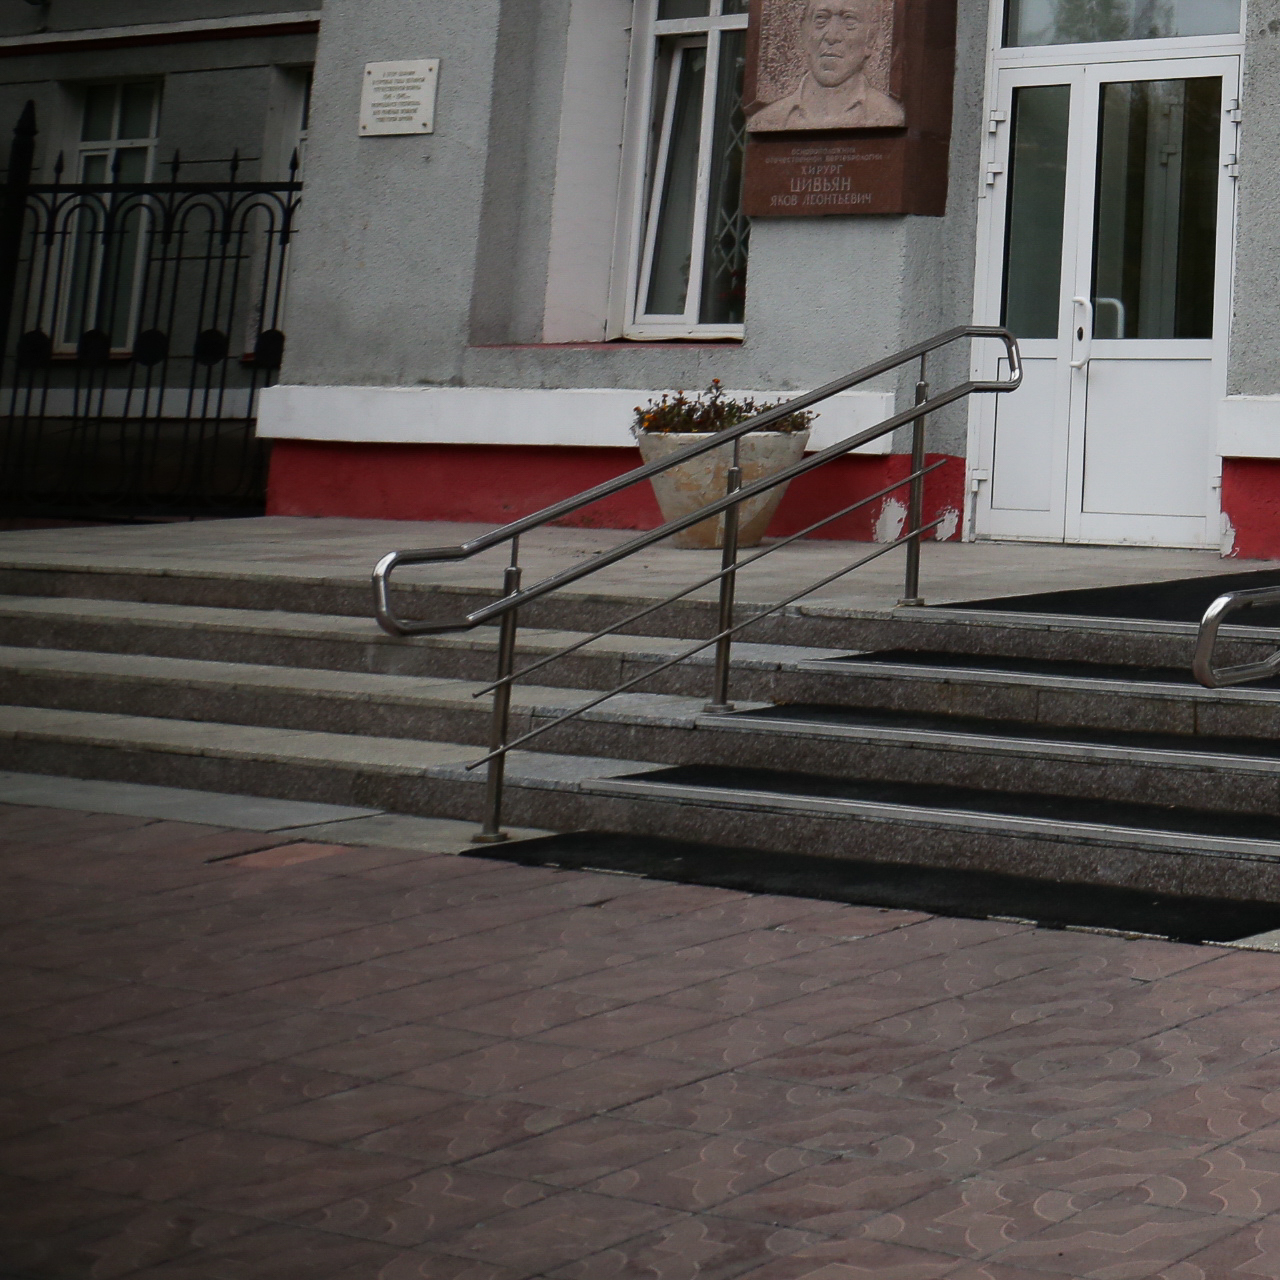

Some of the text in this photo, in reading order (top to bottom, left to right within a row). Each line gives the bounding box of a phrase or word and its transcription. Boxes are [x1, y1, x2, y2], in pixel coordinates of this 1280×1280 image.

[801, 164, 844, 175] ХИРУРГ
[790, 176, 852, 193] ЦИВЬЯН
[769, 193, 873, 207] ЯКОВ ЛЕОНТЬЕВИЧ
